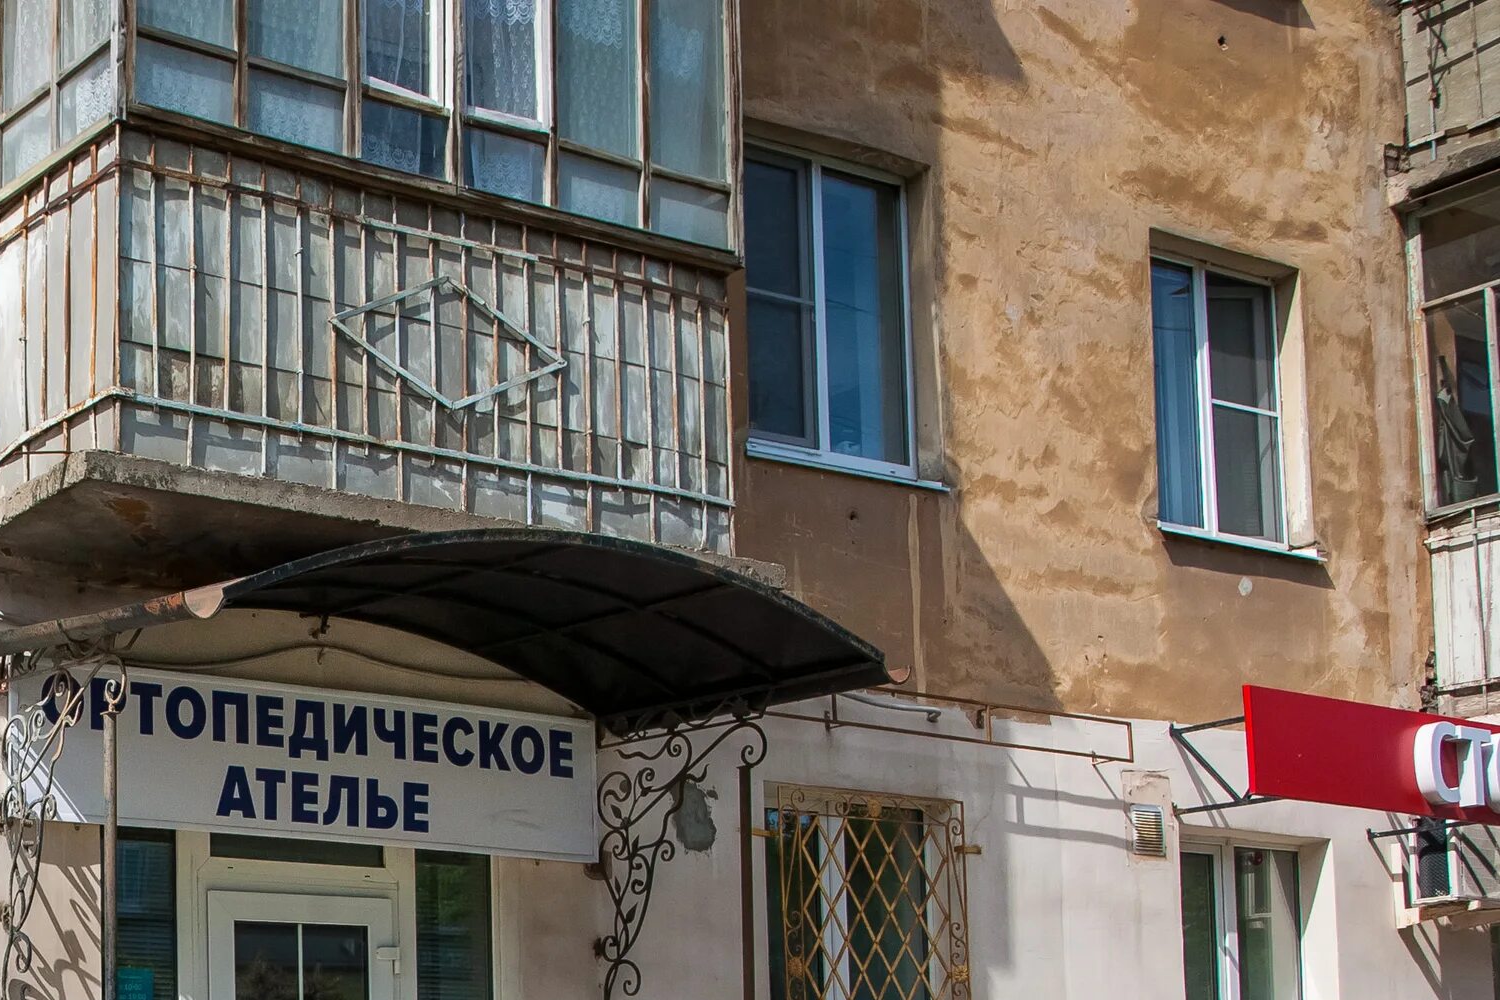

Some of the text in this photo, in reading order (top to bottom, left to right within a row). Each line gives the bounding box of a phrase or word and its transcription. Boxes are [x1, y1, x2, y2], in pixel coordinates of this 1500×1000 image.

[41, 667, 574, 779] ОРТОПЕДИЧЕСКОЕ
[1413, 721, 1500, 814] СТ
[216, 765, 429, 833] АТЕЛЬЕ
